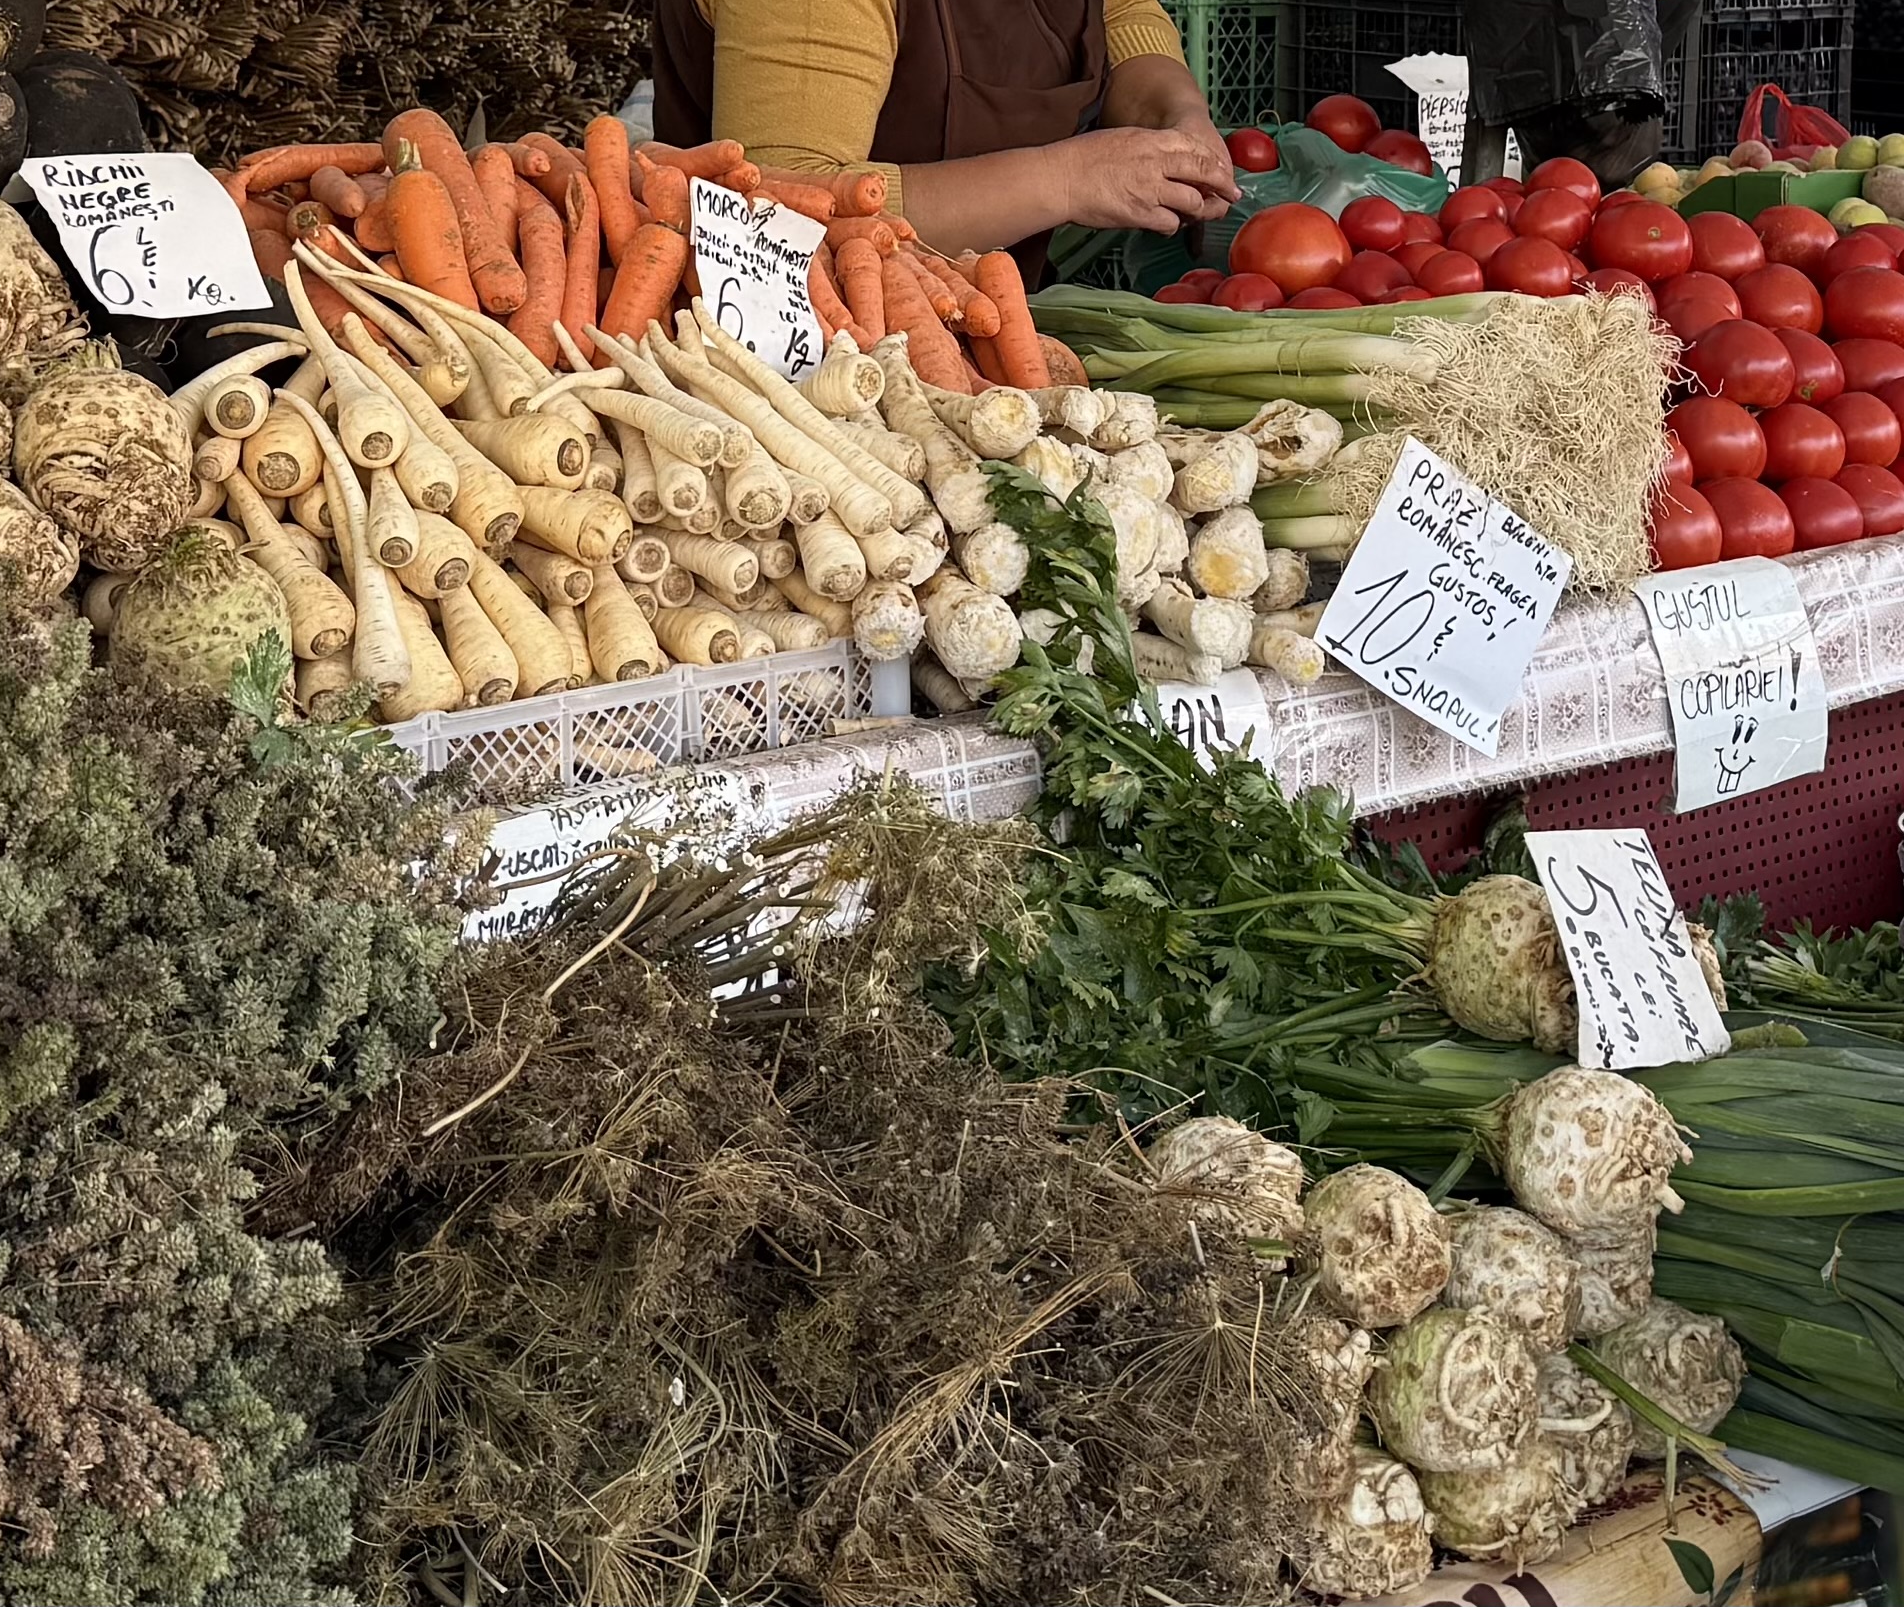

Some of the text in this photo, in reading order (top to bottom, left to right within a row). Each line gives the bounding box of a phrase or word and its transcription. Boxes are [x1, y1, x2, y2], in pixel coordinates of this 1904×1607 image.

[58, 182, 152, 210] NEGRE
[89, 224, 135, 305] 6
[1325, 569, 1435, 665] 10
[1548, 855, 1629, 930] 5
